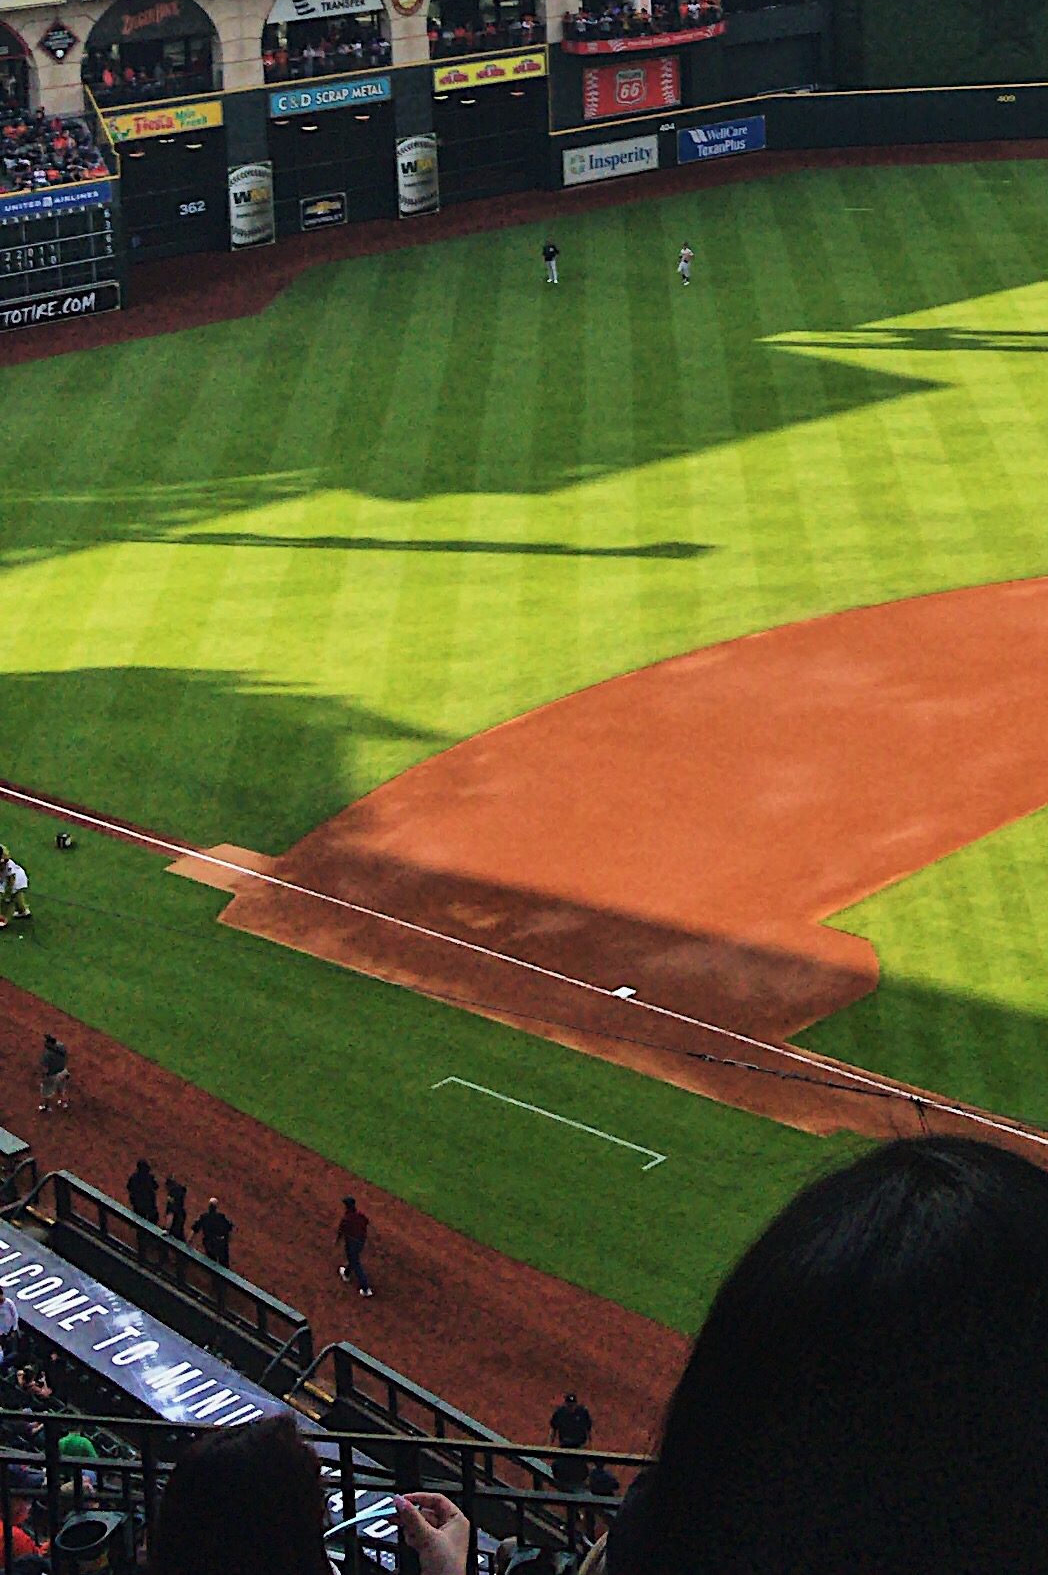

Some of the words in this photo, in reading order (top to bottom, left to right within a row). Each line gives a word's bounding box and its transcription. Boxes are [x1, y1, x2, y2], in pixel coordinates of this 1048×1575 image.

[279, 98, 288, 110] C
[301, 94, 311, 107] D
[316, 88, 348, 105] SCRAP
[351, 85, 384, 99] METAL
[621, 83, 641, 99] 66
[706, 126, 748, 142] WellCare
[697, 139, 746, 157] TexanPlus
[589, 147, 653, 171] Insperity
[5, 200, 41, 212] UNITED
[53, 191, 99, 204] AIRLINES
[179, 201, 206, 216] 362
[92, 1326, 160, 1366] TO
